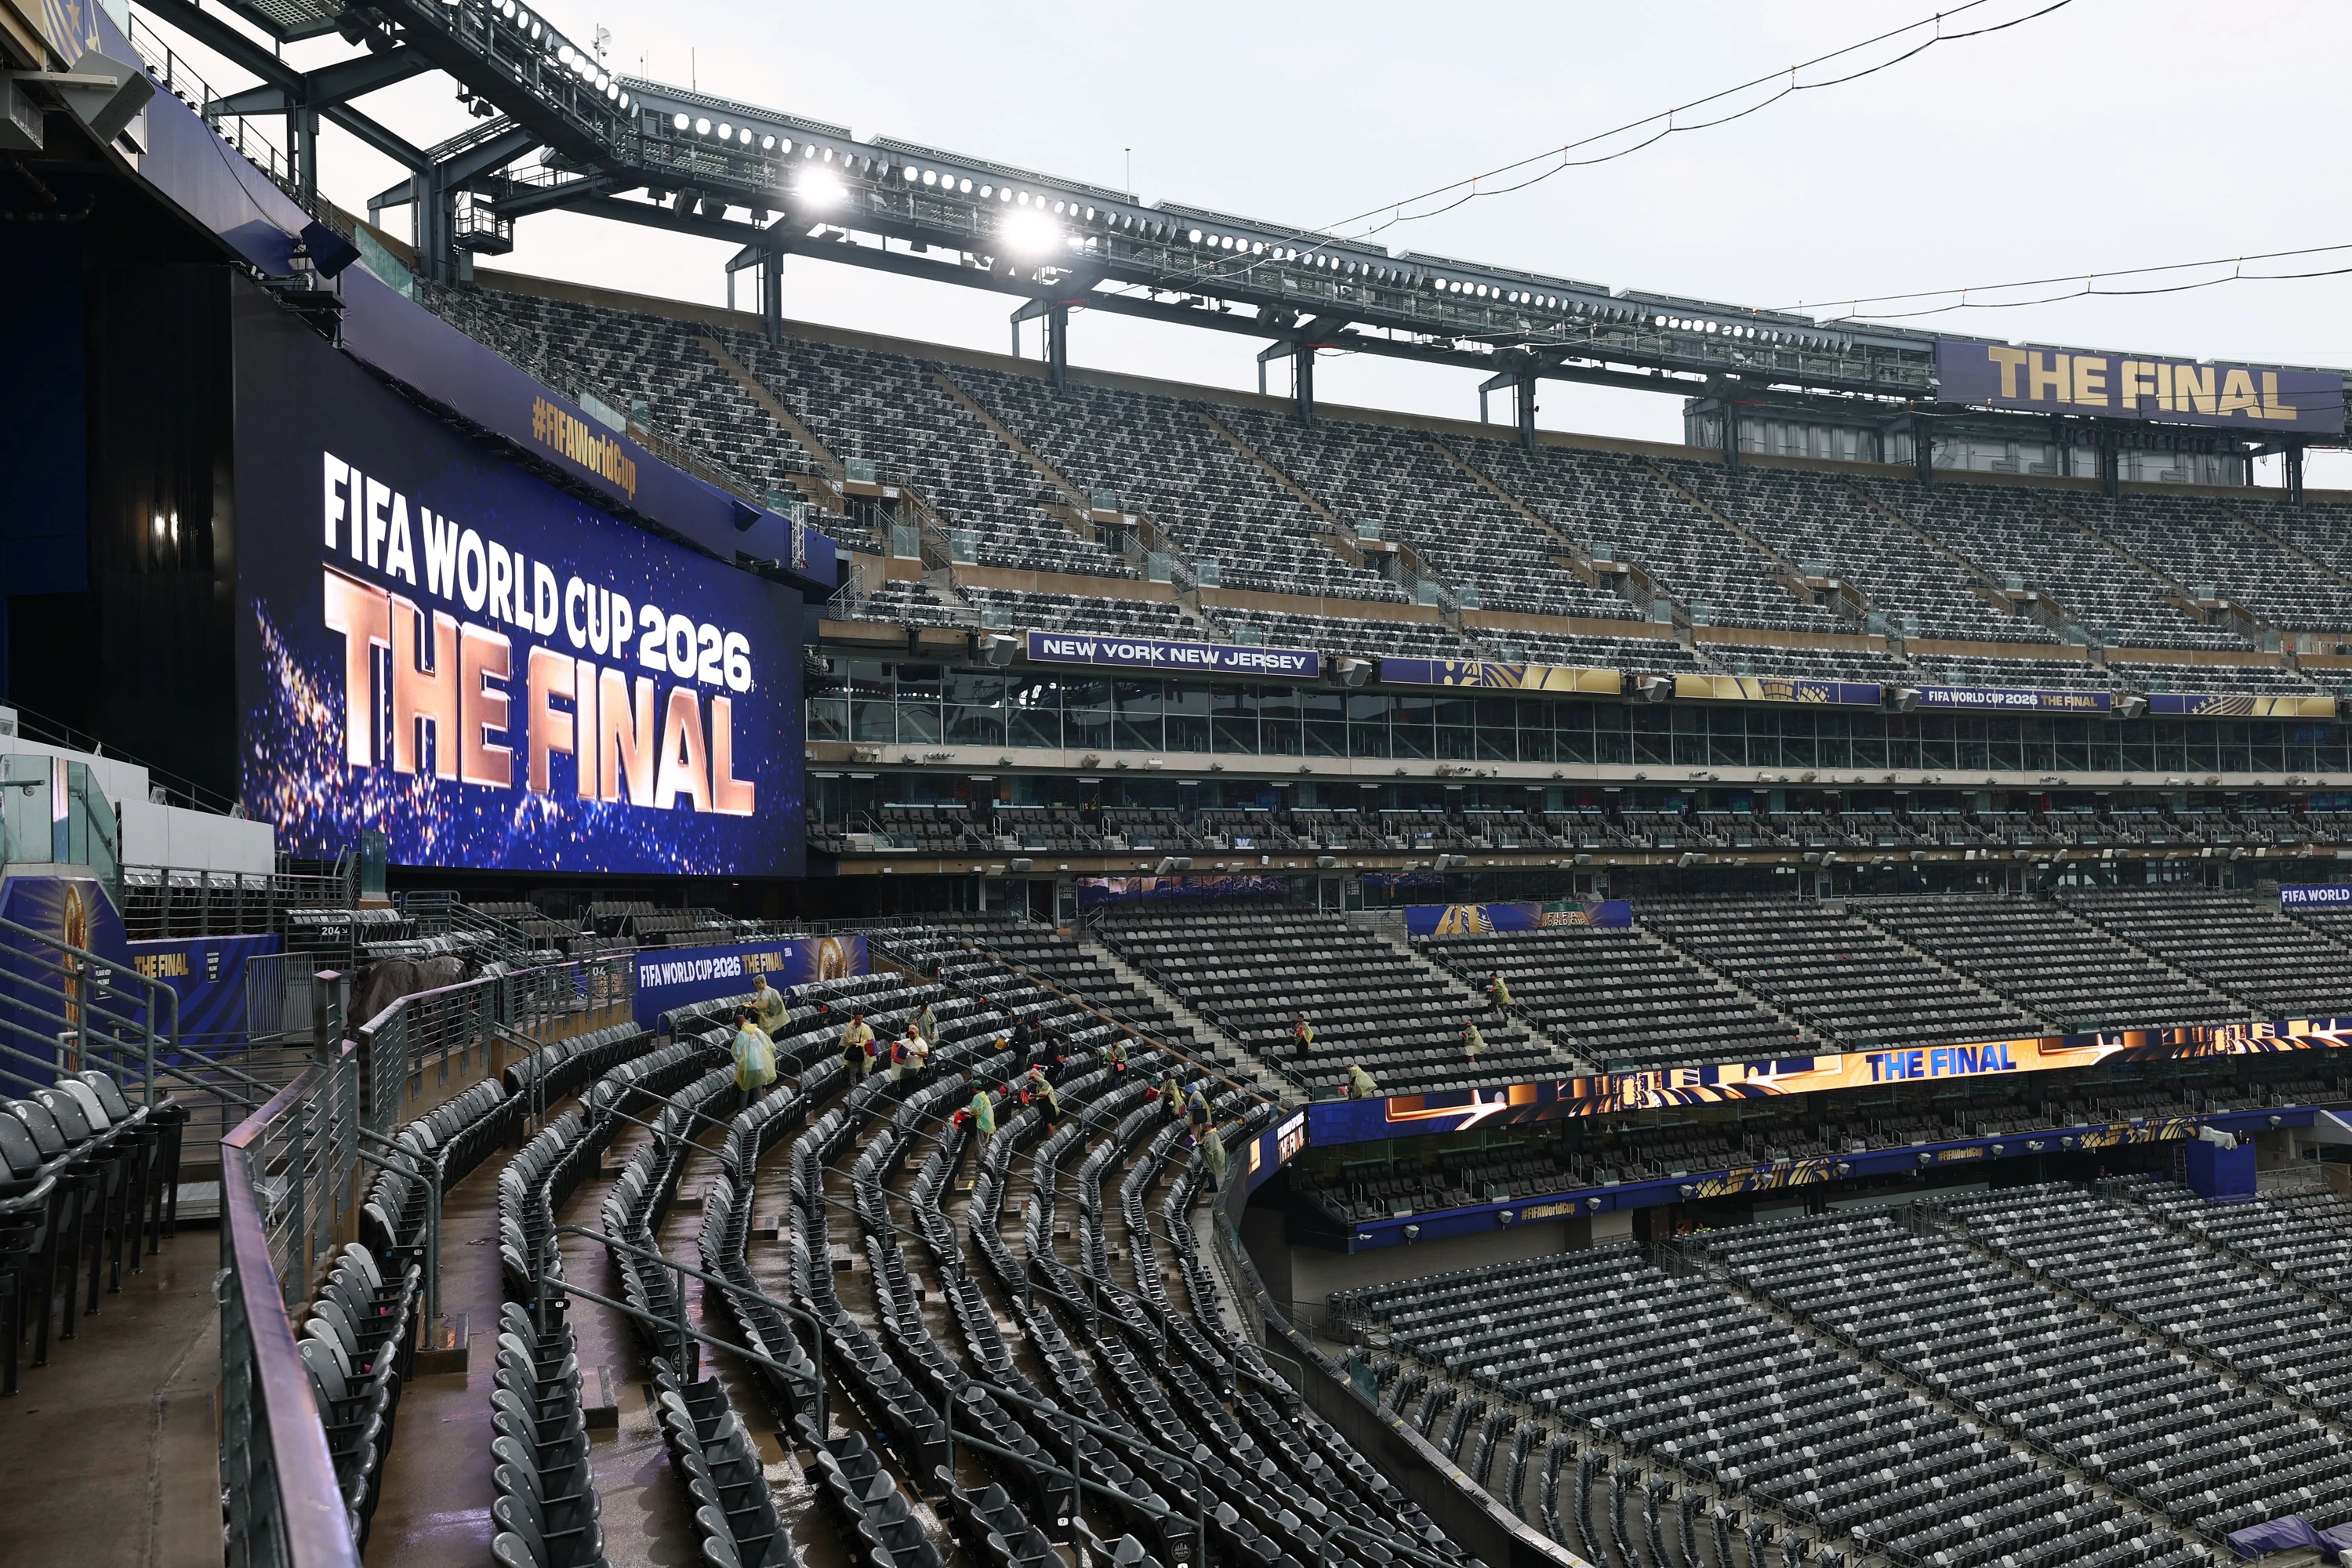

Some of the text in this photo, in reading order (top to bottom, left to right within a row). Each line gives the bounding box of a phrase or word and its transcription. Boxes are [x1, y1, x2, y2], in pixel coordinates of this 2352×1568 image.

[1988, 346, 2297, 420] THE FINAL
[532, 395, 636, 501] #FIFAWorldCup
[324, 451, 751, 694] FIFA WORLD CUP 2026
[1044, 639, 1306, 670] NEW YORK NEW JERSEY
[323, 563, 755, 818] THE FINAL
[1929, 691, 2097, 707] FIFA WORLD CUP 2026 THE FINAL
[2281, 888, 2350, 902] FIFA WORLD
[1541, 918, 1568, 927] WORLD
[1548, 911, 1578, 920] FIFA
[321, 927, 340, 935] 204
[134, 953, 189, 979] THE FINAL
[640, 965, 662, 988] FIFA
[662, 960, 695, 985] WORLD
[695, 959, 713, 981] CUP
[713, 956, 741, 978] 2026
[742, 953, 760, 975] THE
[760, 951, 785, 973] FINAL
[1865, 1044, 2017, 1082] THE FINAL
[1938, 1147, 1983, 1161] #FIFAWorldCup
[1522, 1203, 1575, 1221] #FIFAWorldCup
